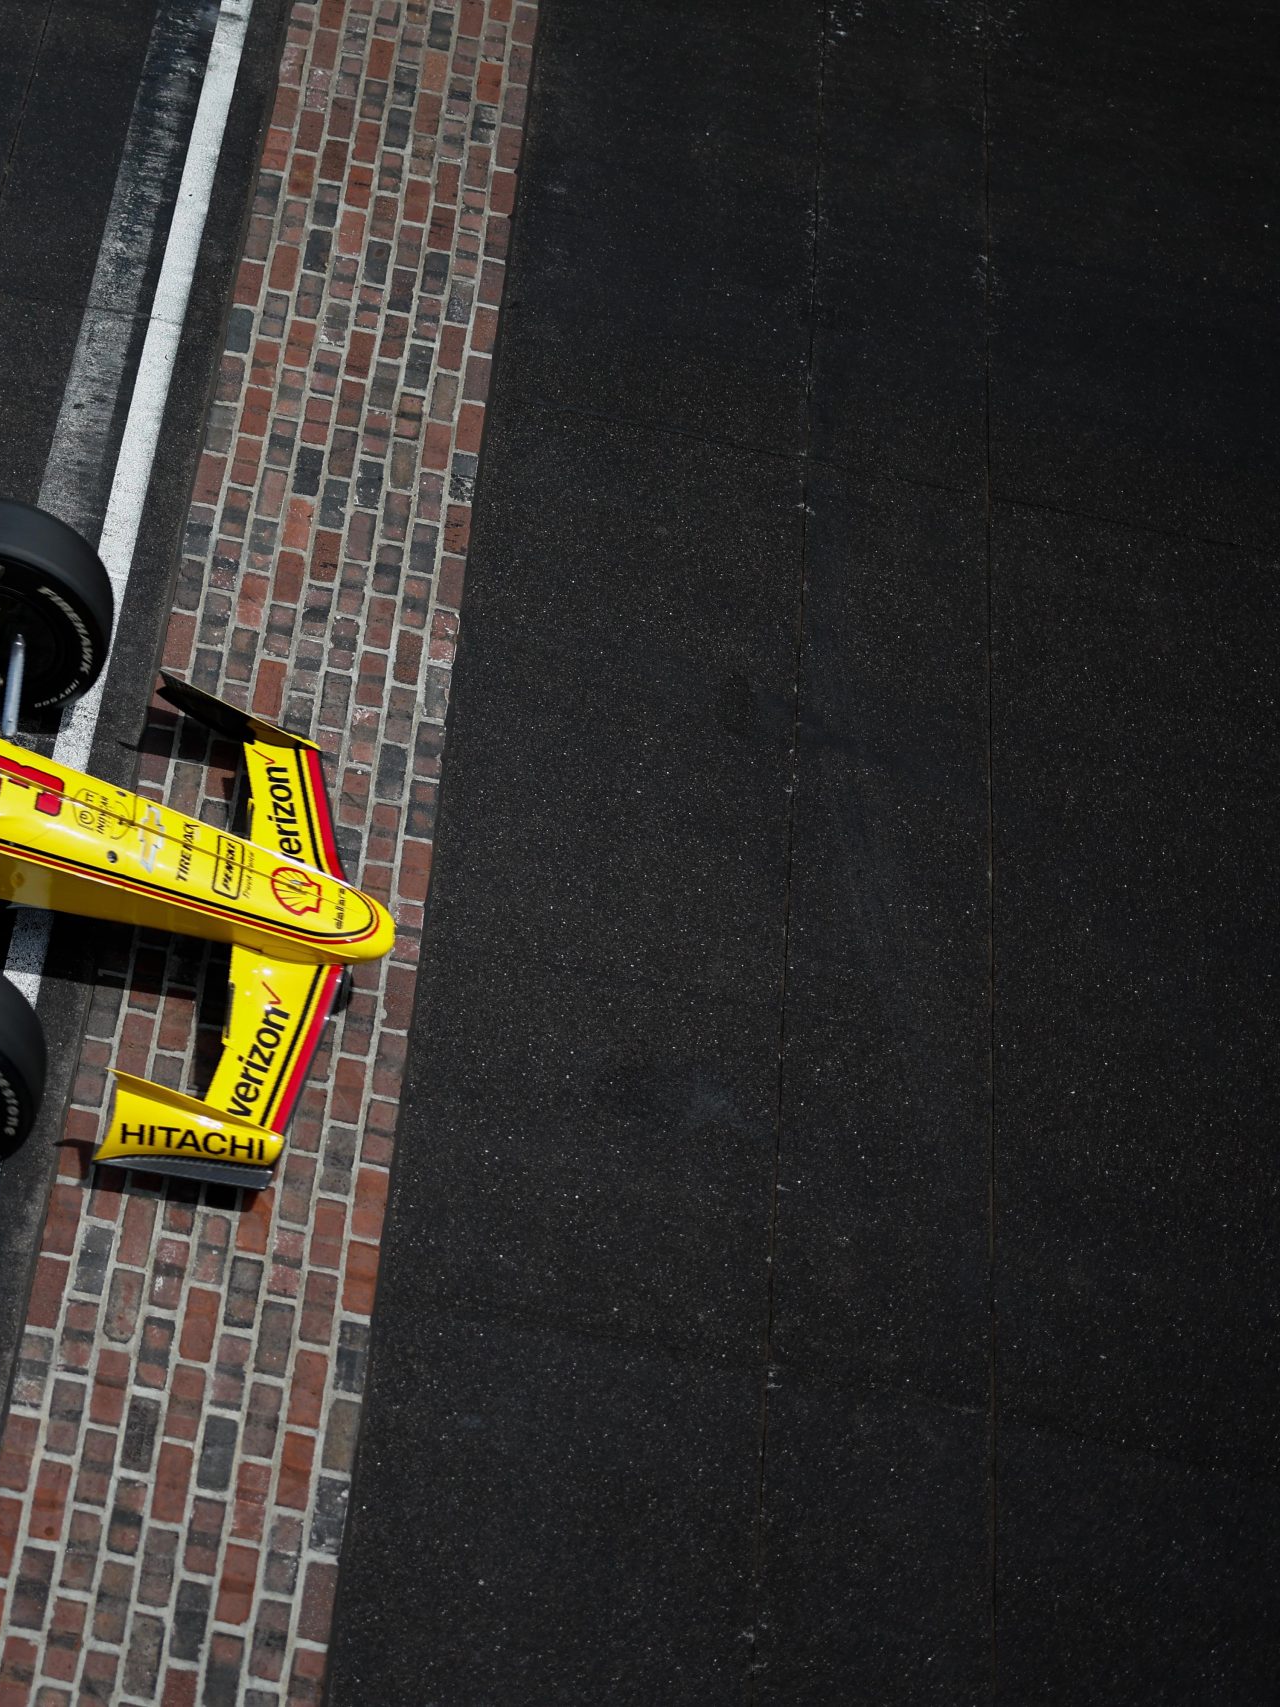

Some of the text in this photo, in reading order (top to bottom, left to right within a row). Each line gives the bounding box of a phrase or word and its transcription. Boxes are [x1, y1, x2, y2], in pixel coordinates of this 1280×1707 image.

[176, 850, 193, 882] TIRE
[334, 887, 346, 930] dallara
[227, 1007, 290, 1117] verizon
[120, 1123, 265, 1161] HITACHI
